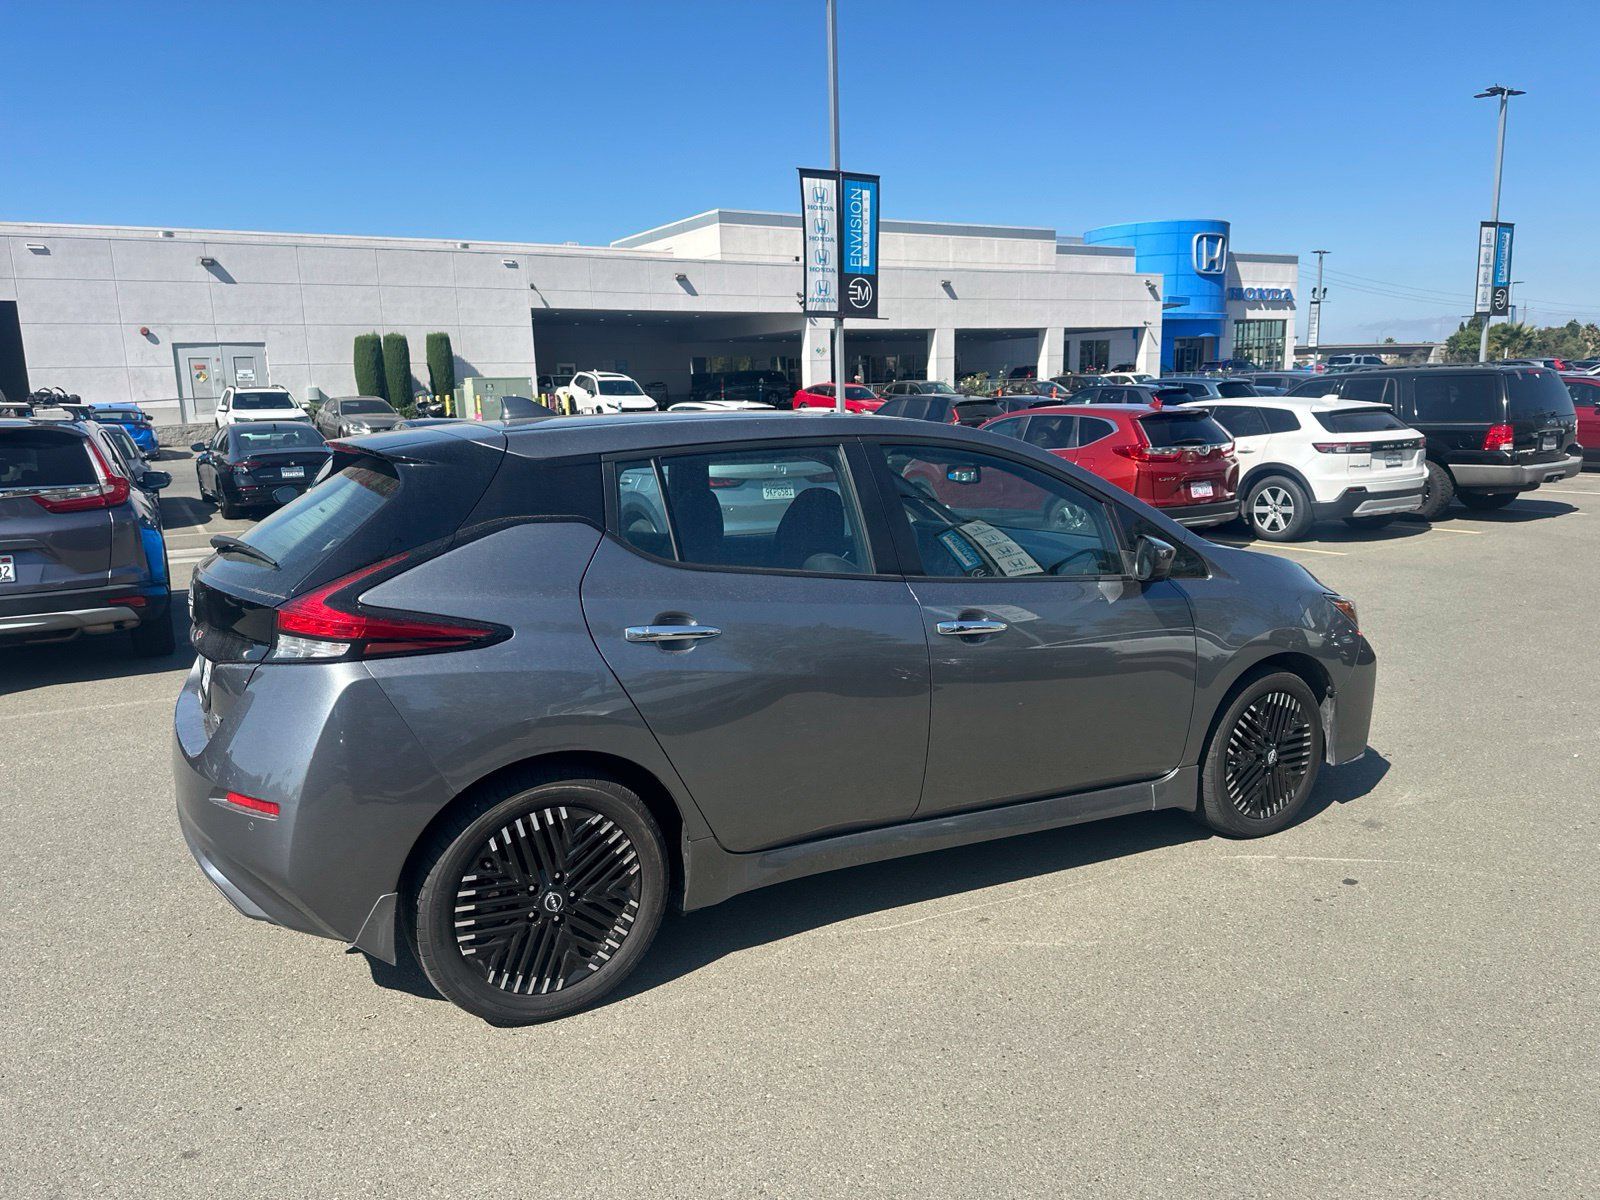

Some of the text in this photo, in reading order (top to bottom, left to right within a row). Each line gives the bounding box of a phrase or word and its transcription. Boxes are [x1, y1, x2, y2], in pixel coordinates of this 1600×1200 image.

[807, 204, 834, 212] HONDA
[850, 188, 862, 267] ENVISION
[808, 235, 835, 243] HONDA
[1229, 287, 1294, 301] HONDA
